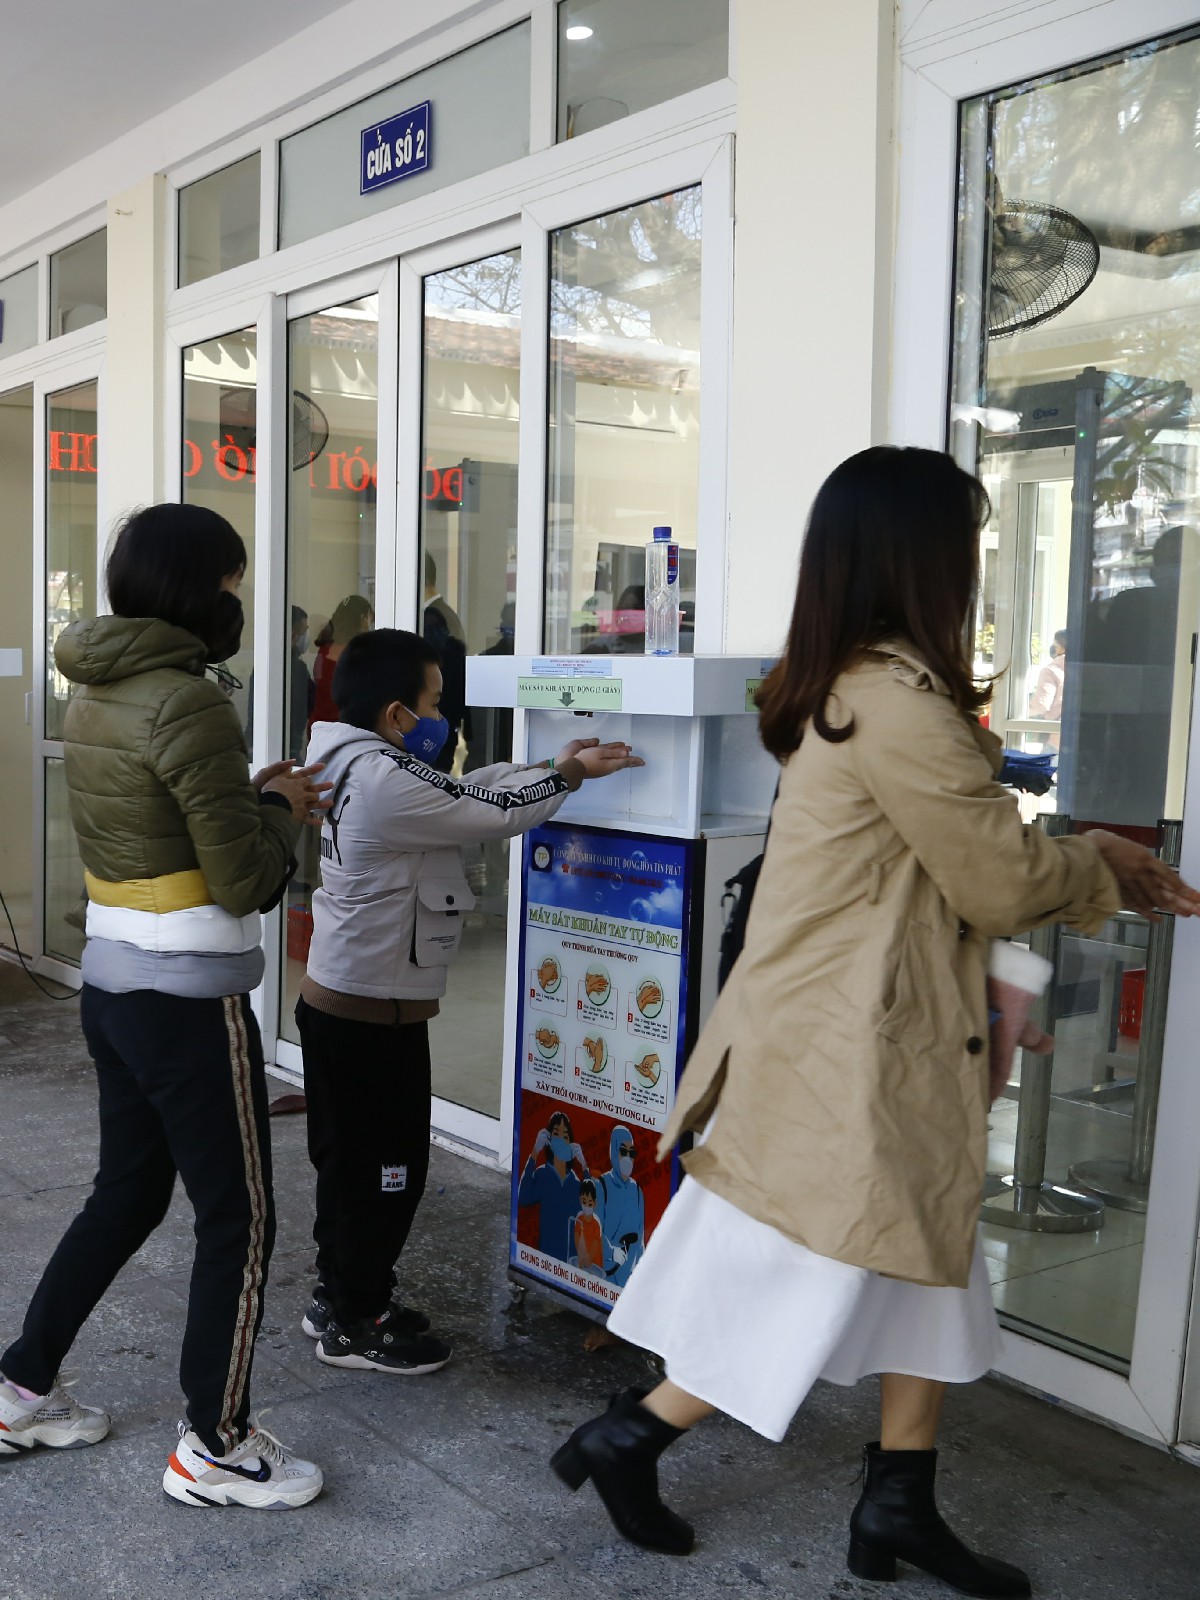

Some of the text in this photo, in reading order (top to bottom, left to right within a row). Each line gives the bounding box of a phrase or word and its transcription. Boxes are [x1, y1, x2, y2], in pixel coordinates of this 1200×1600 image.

[367, 122, 425, 180] CỬA SỐ 2
[407, 763, 447, 788] PUMA
[521, 779, 555, 802] PUMA
[529, 907, 550, 923] MÁY
[551, 911, 570, 928] SÁT
[608, 923, 629, 939] TAY
[630, 927, 645, 945] TỰ
[646, 930, 679, 949] ĐỘNG
[597, 947, 606, 956] TAY
[627, 953, 639, 963] QUY
[569, 1091, 588, 1105] QUEN
[593, 1098, 614, 1112] DỰNG
[614, 1105, 641, 1121] TƯƠNG
[642, 1114, 657, 1126] LAI
[521, 1250, 539, 1266] CHUNG
